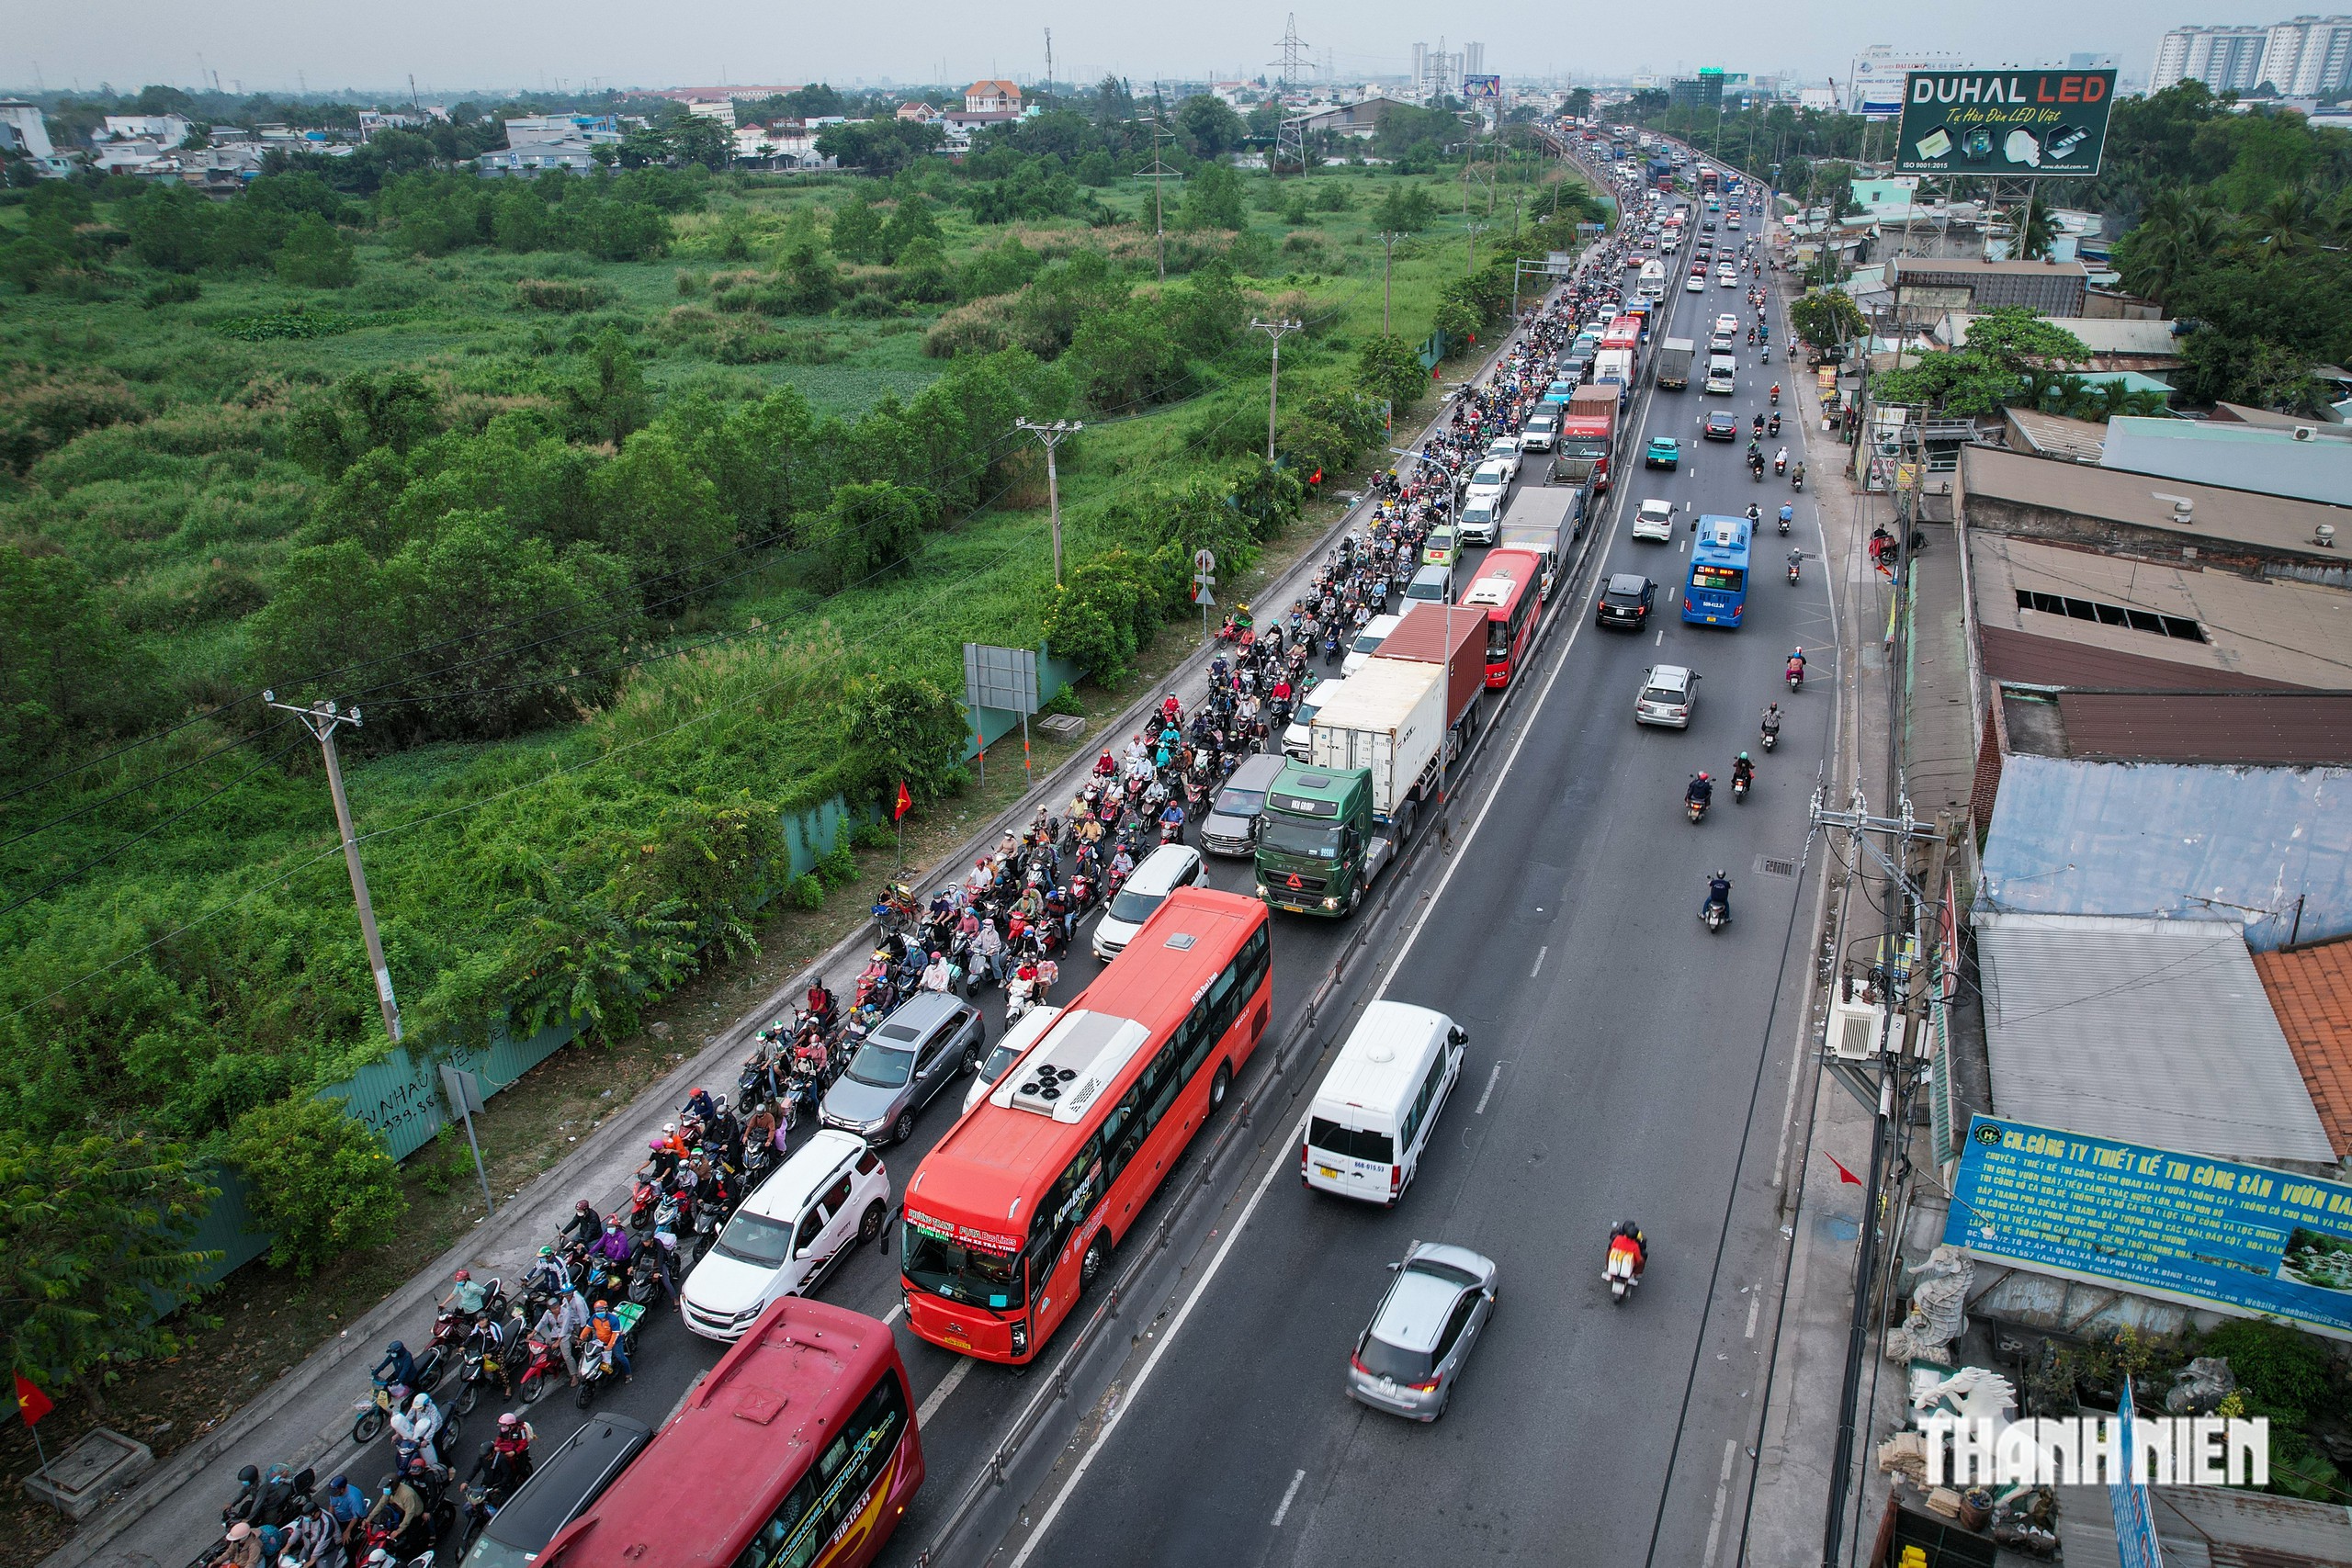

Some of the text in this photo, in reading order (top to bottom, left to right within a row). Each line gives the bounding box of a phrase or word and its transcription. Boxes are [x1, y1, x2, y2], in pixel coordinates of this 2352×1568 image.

[1913, 76, 2106, 103] DUHAL LED
[1946, 108, 2062, 125] Tự Hào Đèn LED Việt
[2003, 1131, 2065, 1157] CN.CÔNG
[2069, 1143, 2088, 1161] TY
[2092, 1146, 2135, 1170] THIẾT
[2137, 1154, 2164, 1176] KẾ
[2165, 1160, 2190, 1180] THI
[2192, 1165, 2235, 1190] CÔNG
[2237, 1174, 2273, 1197] SÂN
[2281, 1183, 2326, 1208] VƯỜN
[909, 1209, 1016, 1247] PHƯƠNG TRANG FUTA Bus Lines
[778, 1441, 872, 1564] MOBIHOME PREMIUM X
